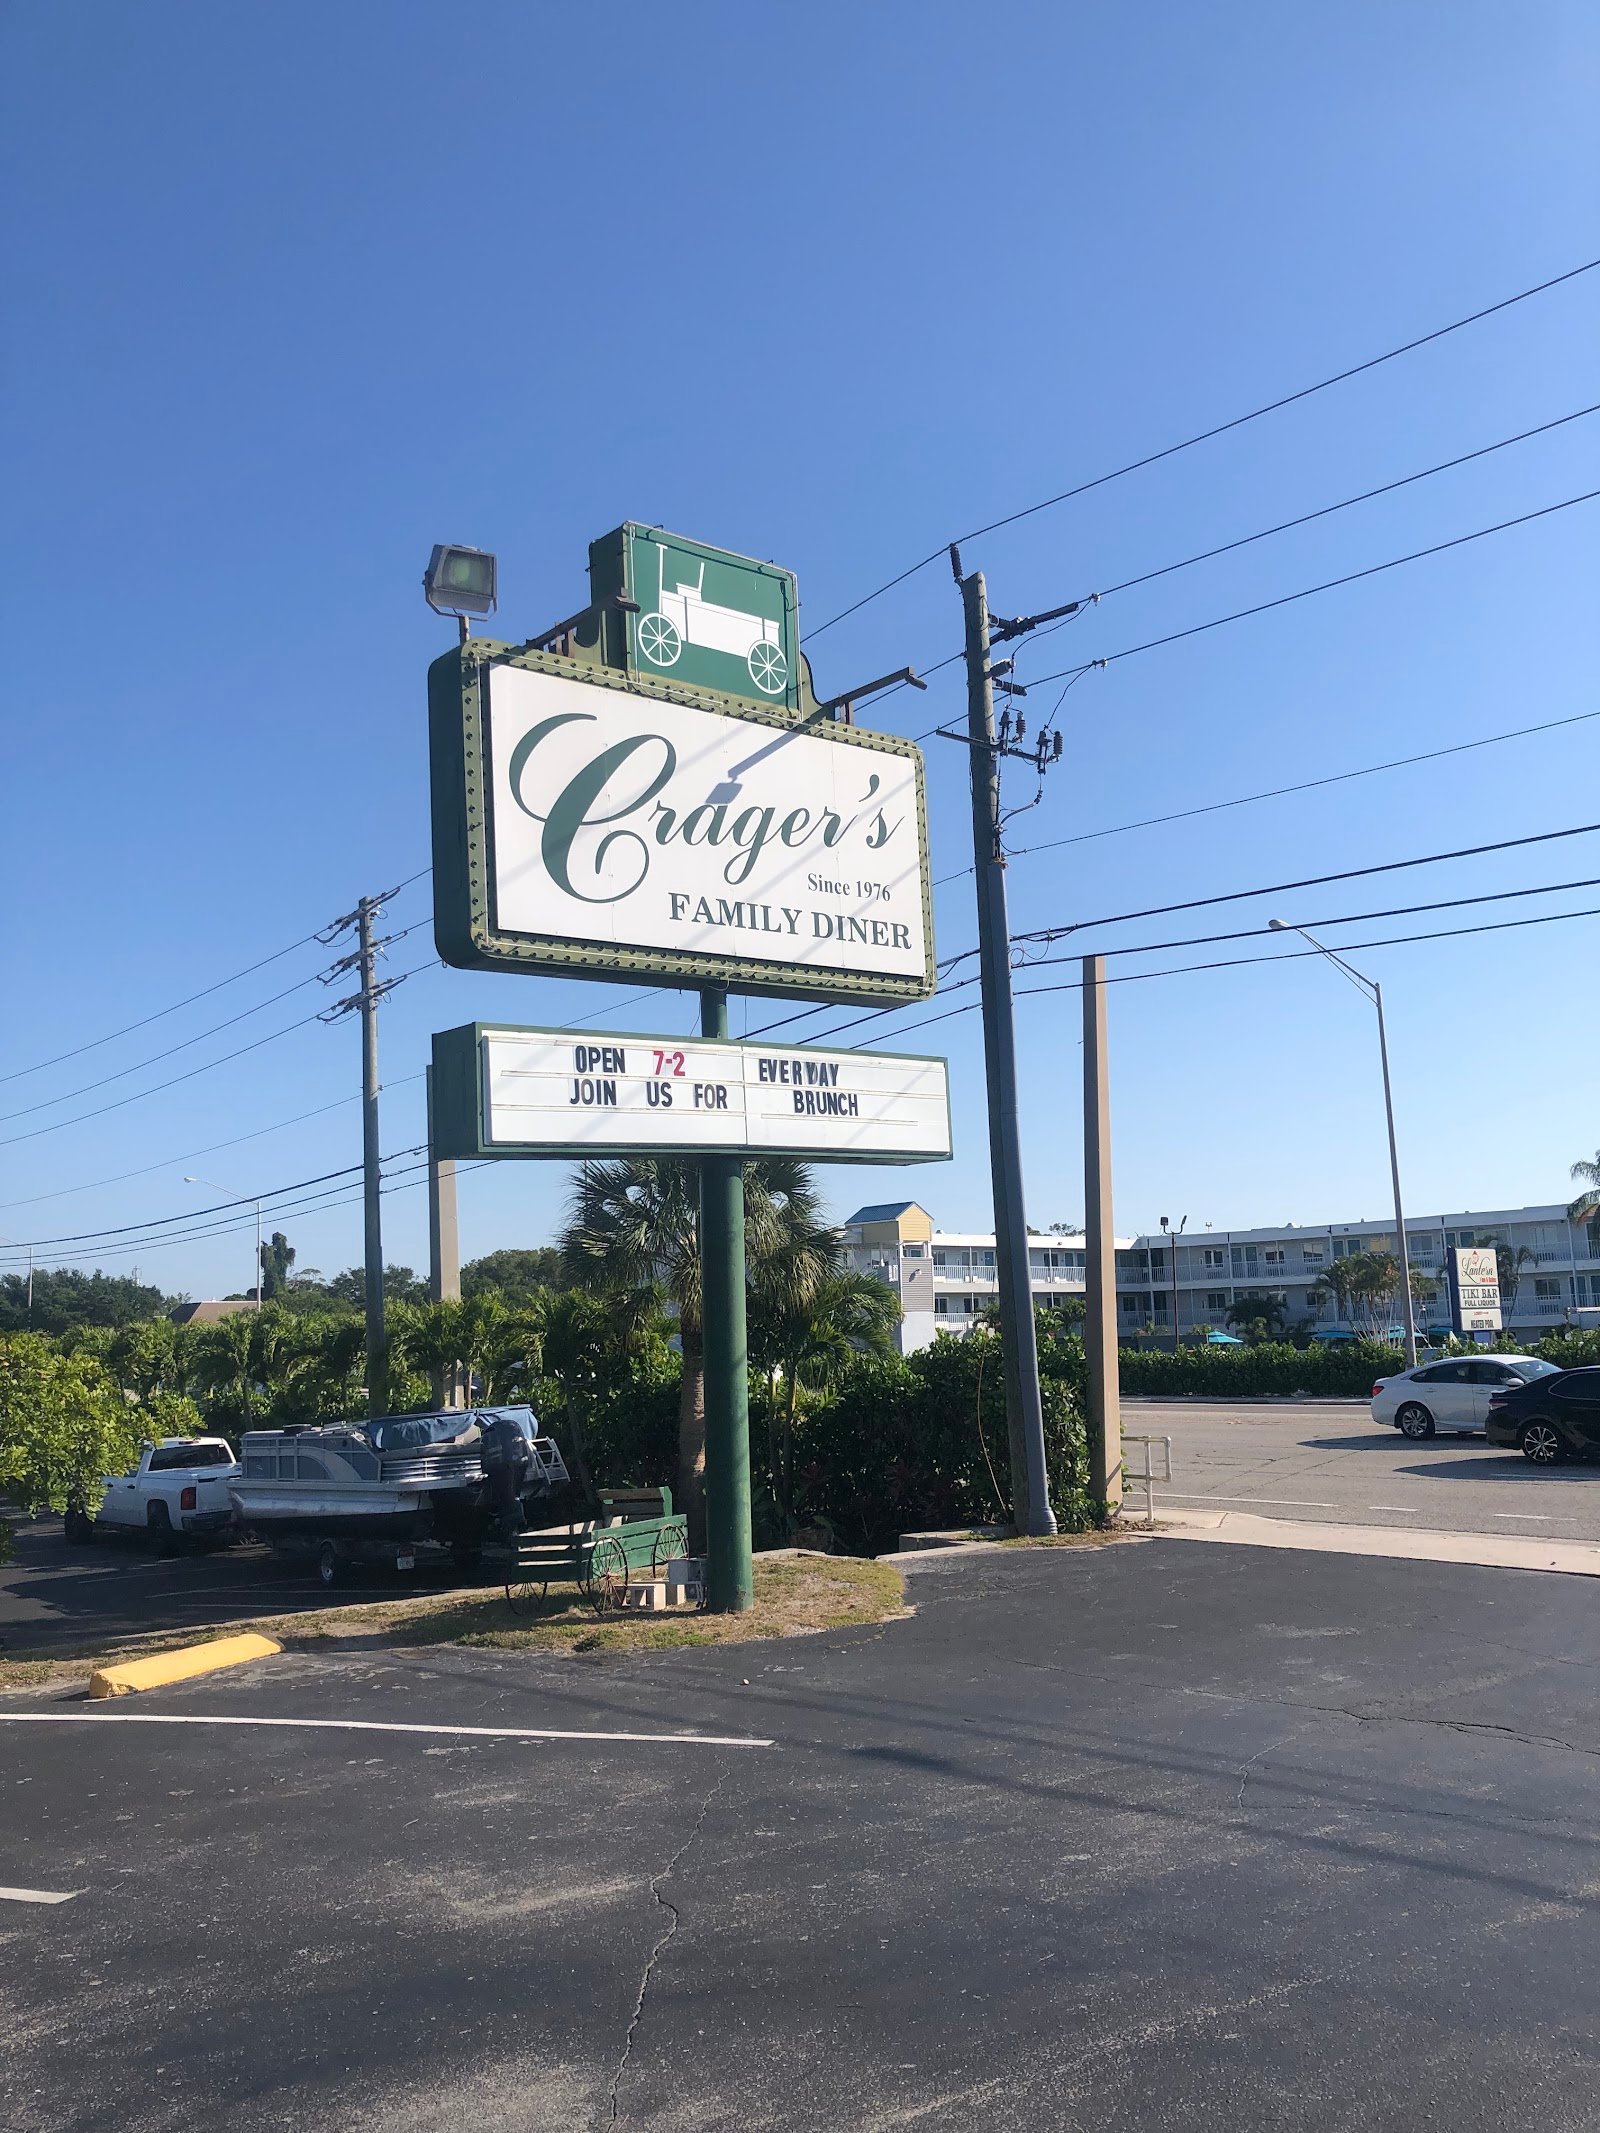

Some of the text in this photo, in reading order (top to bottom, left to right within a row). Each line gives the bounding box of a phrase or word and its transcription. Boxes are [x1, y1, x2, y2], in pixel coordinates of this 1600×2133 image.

[508, 712, 905, 904] Crager's
[806, 871, 892, 903] Since 1976
[668, 891, 912, 950] FAMILY DINER
[574, 1045, 626, 1074] OPEN
[652, 1050, 686, 1077] 7-2
[569, 1078, 859, 1117] JOIN US FOR BRUNCH
[1461, 1288, 1498, 1299] TIKI BAR
[1464, 1299, 1496, 1307] FULL LIQUOR
